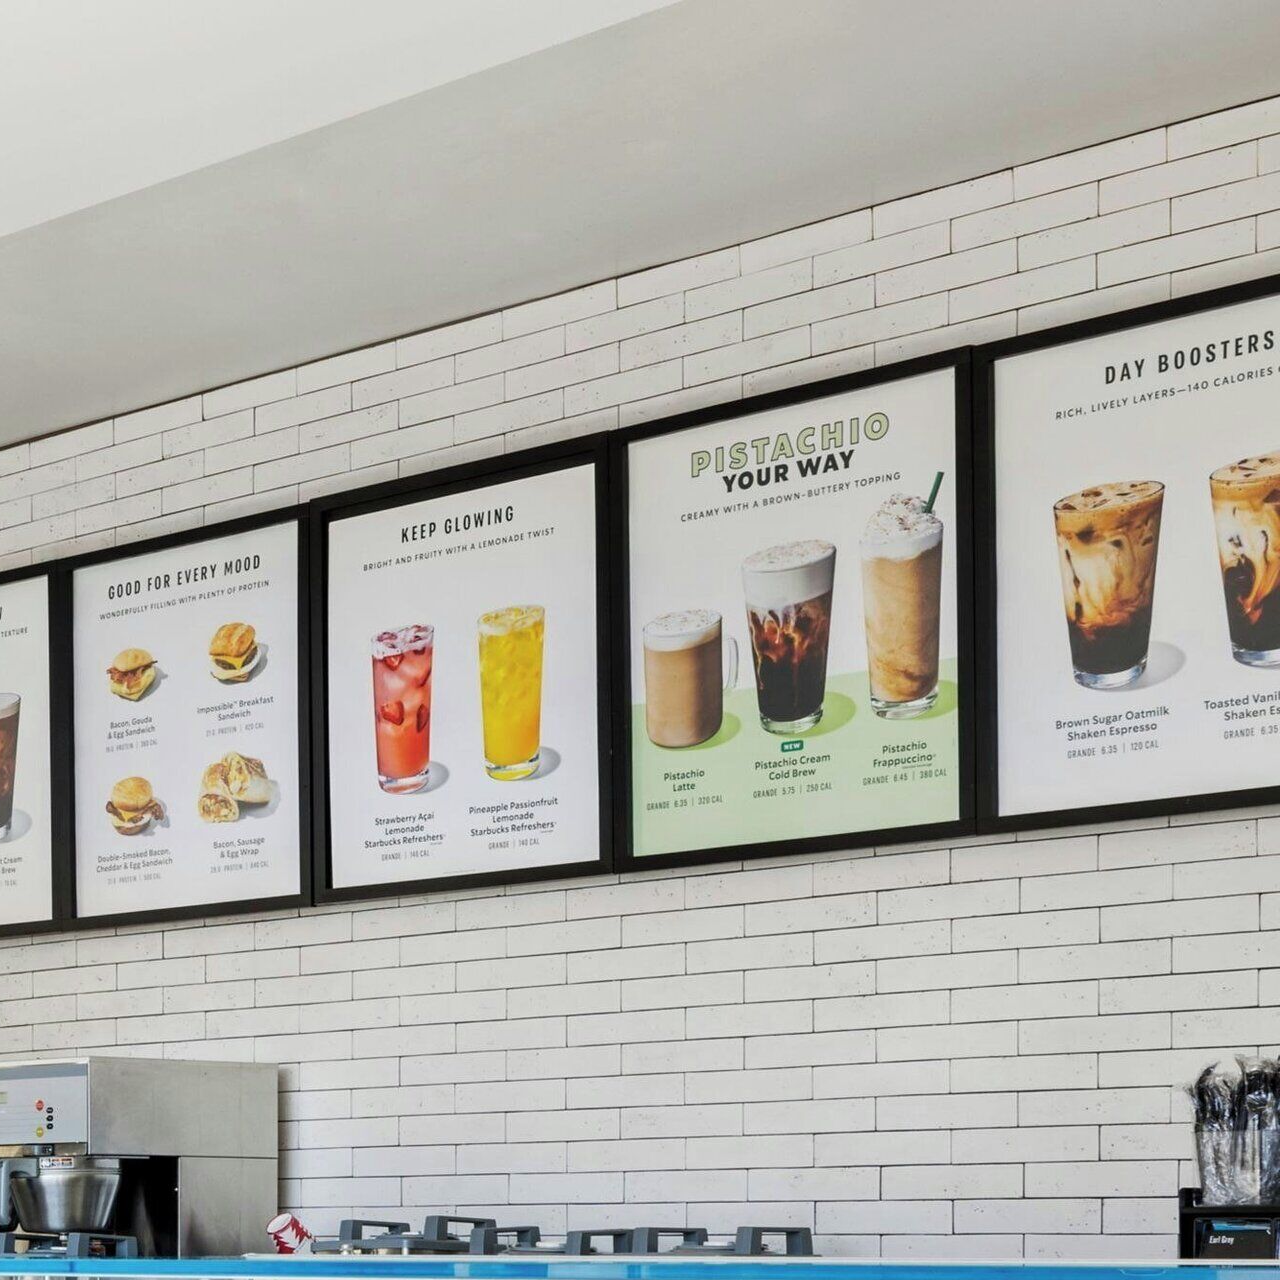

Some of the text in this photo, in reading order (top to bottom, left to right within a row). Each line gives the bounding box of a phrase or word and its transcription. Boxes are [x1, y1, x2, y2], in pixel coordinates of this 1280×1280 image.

[1105, 330, 1274, 384] DAY BOOSTERS
[1055, 405, 1087, 420] RICH,
[1091, 397, 1128, 412] LIVELY
[1213, 366, 1273, 387] CALORIES
[691, 412, 890, 478] PISTACHIO
[722, 450, 855, 493] YOUR WAY
[680, 508, 720, 522] CREAMY
[723, 503, 749, 514] WITH
[753, 500, 759, 508] A
[854, 471, 901, 488] TOPPING
[402, 505, 514, 543] KEEP GLOWING
[363, 559, 392, 571] BRIGHT
[395, 556, 412, 565] AND
[415, 549, 443, 562] FRUITY
[446, 545, 468, 555] WITH
[479, 533, 525, 549] LEMONADE
[528, 527, 555, 539] TWIST
[108, 555, 260, 600] GOOD FOR EVERY MOOD
[100, 580, 270, 620] WONDERFULLY FILLING WITH PLENTY OF PROTEIN
[1, 627, 28, 638] TEXTURE
[239, 696, 273, 708] Breakfast
[1204, 695, 1249, 710] Toasted
[132, 716, 152, 725] Gouda
[218, 709, 251, 721] Sandwich
[1055, 706, 1169, 730] Brown Sugar Oatmilk
[1224, 707, 1267, 721] Shaken
[113, 730, 124, 739] Egg
[126, 725, 155, 737] Sandwich
[1067, 722, 1158, 742] Shaken Espresso
[1223, 727, 1255, 739] GRANDE
[882, 741, 927, 754] Pistachio
[1067, 747, 1096, 759] GRANDE
[1131, 742, 1143, 751] 120
[1145, 740, 1159, 749] CAL
[754, 754, 831, 770] Pistachio Cream
[664, 769, 705, 782] Pistachio
[769, 768, 816, 781] Cold Brew
[862, 775, 888, 786] GRANDE
[934, 768, 947, 777] CAL
[673, 783, 696, 792] Latte
[753, 788, 777, 799] GRANDE
[806, 784, 820, 793] 250
[469, 797, 558, 815] Pineapple Passionfruit
[647, 800, 670, 811] GRANDE
[711, 795, 723, 804] CAL
[375, 814, 417, 826] Strawberry
[493, 811, 534, 824] Lemonade
[385, 824, 424, 835] Lemonade
[471, 825, 509, 837] Starbucks
[237, 837, 265, 847] Sausage
[365, 837, 401, 848] Starbucks
[4, 856, 22, 864] Cream
[226, 850, 239, 859] Egg
[240, 848, 259, 857] Wrap
[97, 863, 122, 873] Cheddar
[130, 861, 141, 870] Egg
[142, 857, 172, 868] Sandwich
